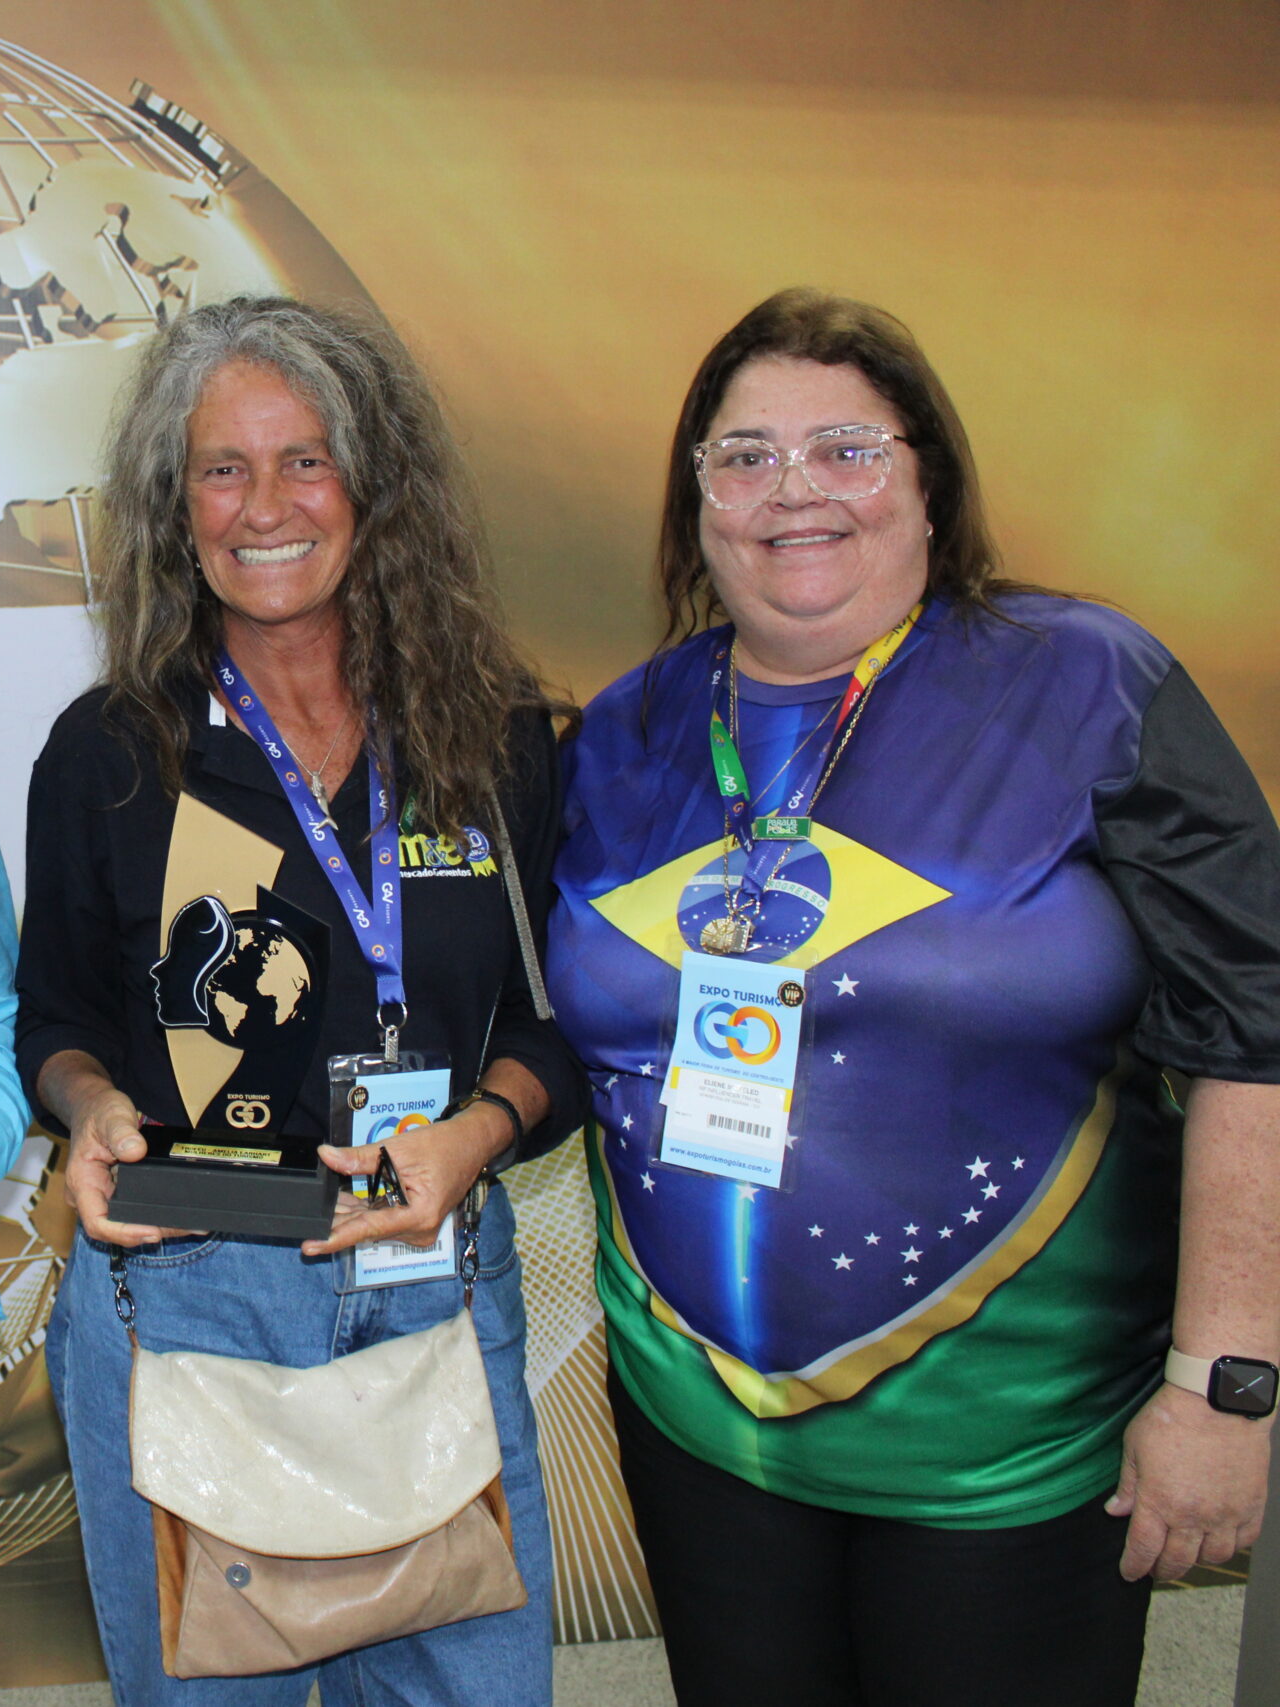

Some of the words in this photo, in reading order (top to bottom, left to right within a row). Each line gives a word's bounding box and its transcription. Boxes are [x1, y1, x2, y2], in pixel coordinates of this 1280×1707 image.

[382, 882, 394, 904] GAV
[352, 908, 370, 928] GAV
[700, 984, 730, 998] EXPO
[734, 990, 784, 1007] TURISMO
[784, 990, 800, 1000] VIP
[354, 1094, 366, 1104] VIP
[370, 1103, 394, 1114] EXPO
[397, 1099, 436, 1112] TURISMO
